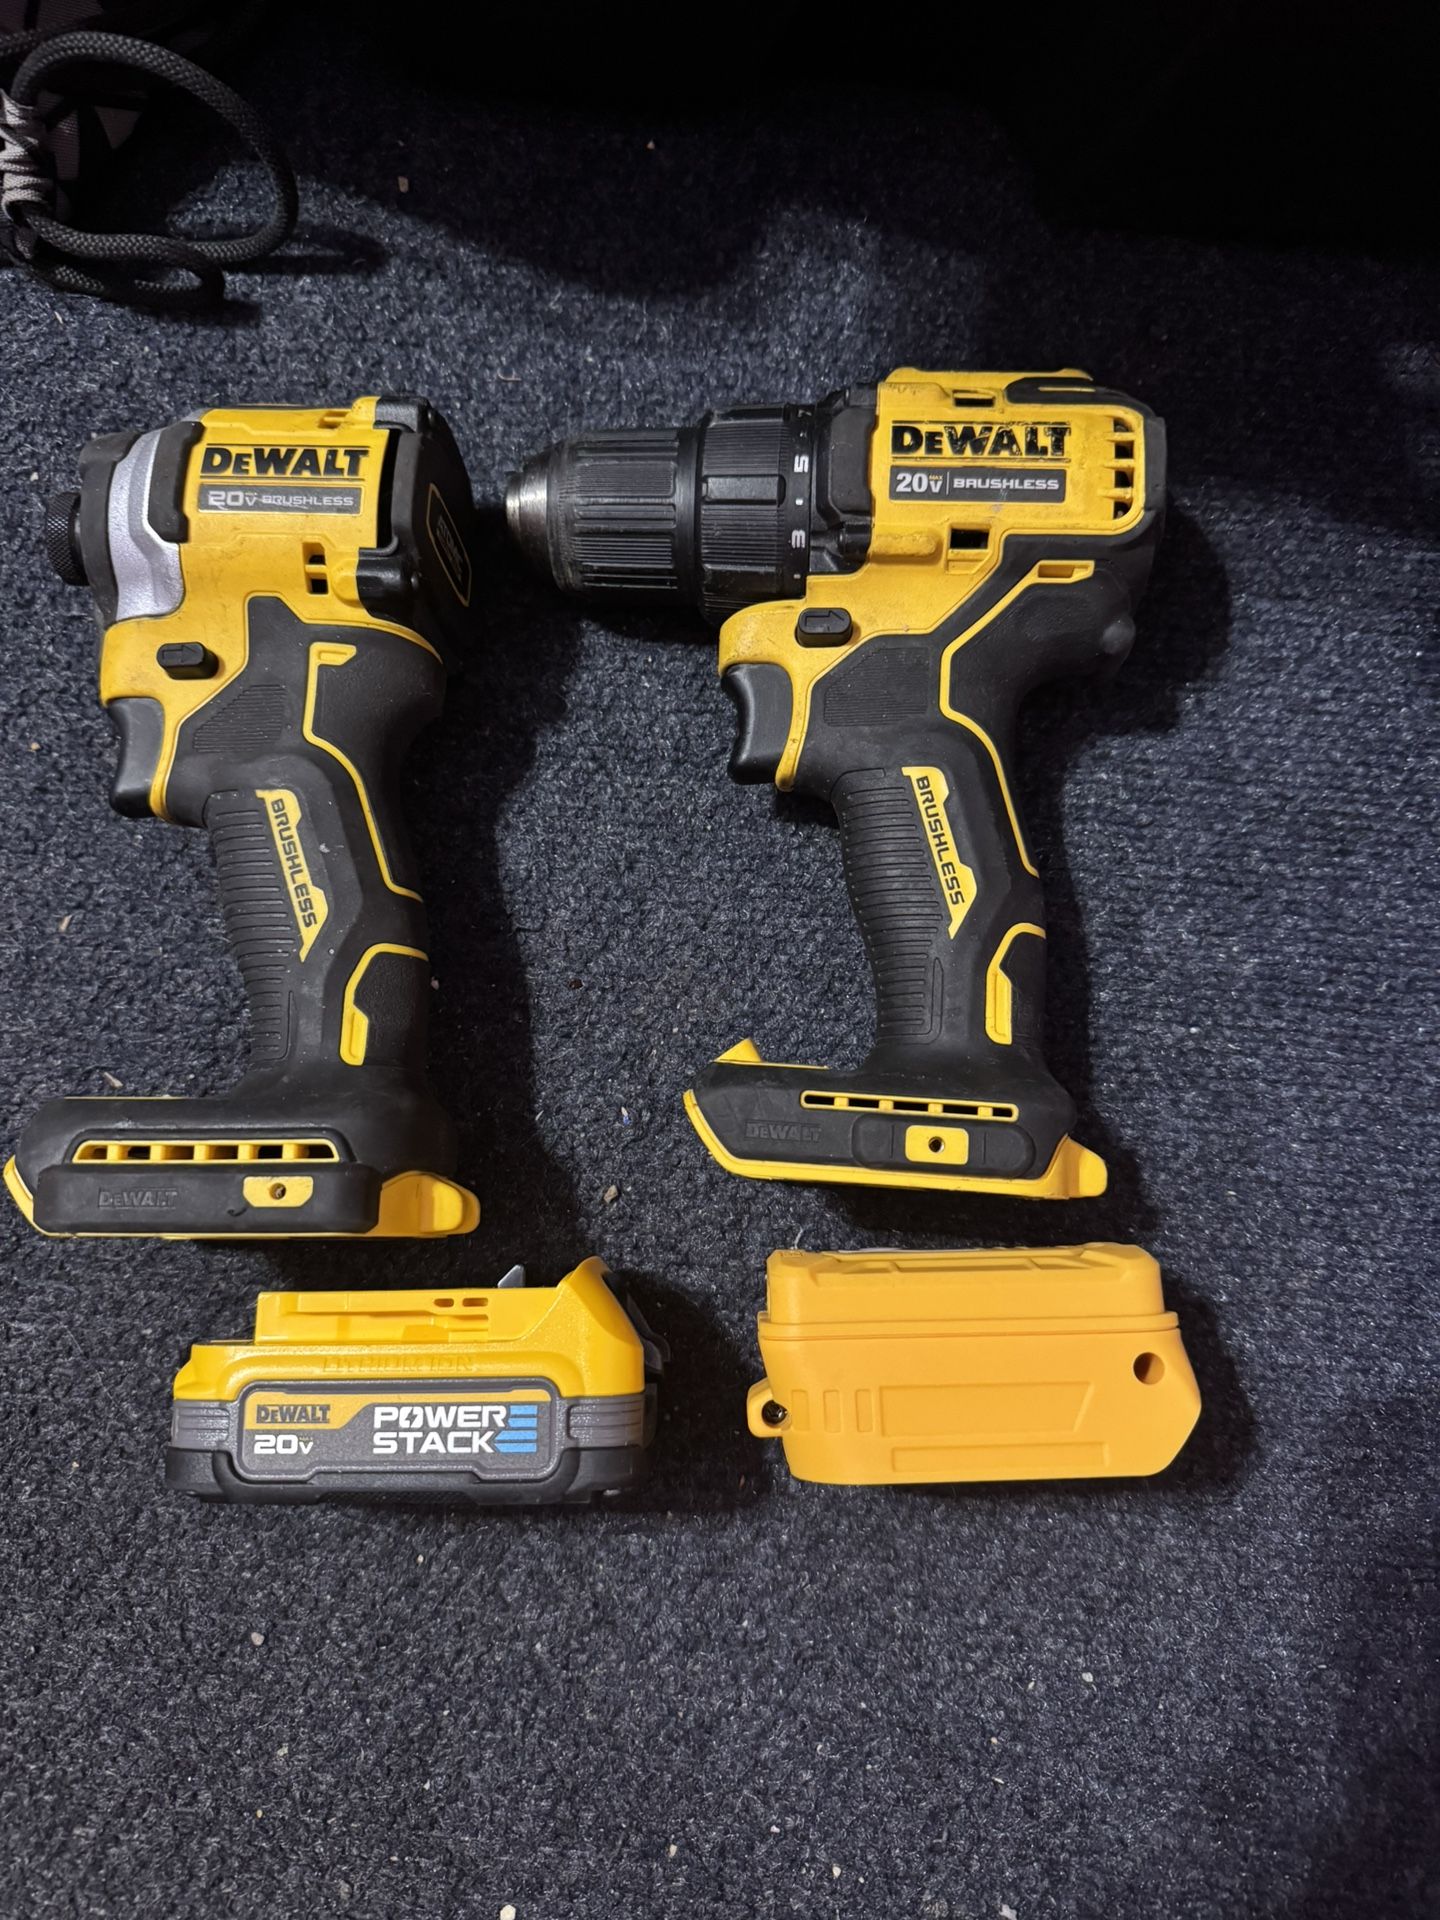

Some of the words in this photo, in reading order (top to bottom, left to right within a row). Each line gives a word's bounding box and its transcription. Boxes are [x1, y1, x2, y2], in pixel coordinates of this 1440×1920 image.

[892, 425, 1071, 456] DEWALT
[200, 447, 369, 476] DEWALT
[794, 455, 809, 473] 5
[953, 477, 1060, 491] BRUSHLESS
[261, 494, 354, 508] BRUSHLESS
[791, 529, 806, 548] 3
[915, 775, 965, 906] BRUSHLESS
[270, 798, 318, 928] BRUSHLESS
[256, 1404, 331, 1424] DEWALT
[373, 1405, 507, 1429] POWER
[372, 1431, 495, 1454] STACK
